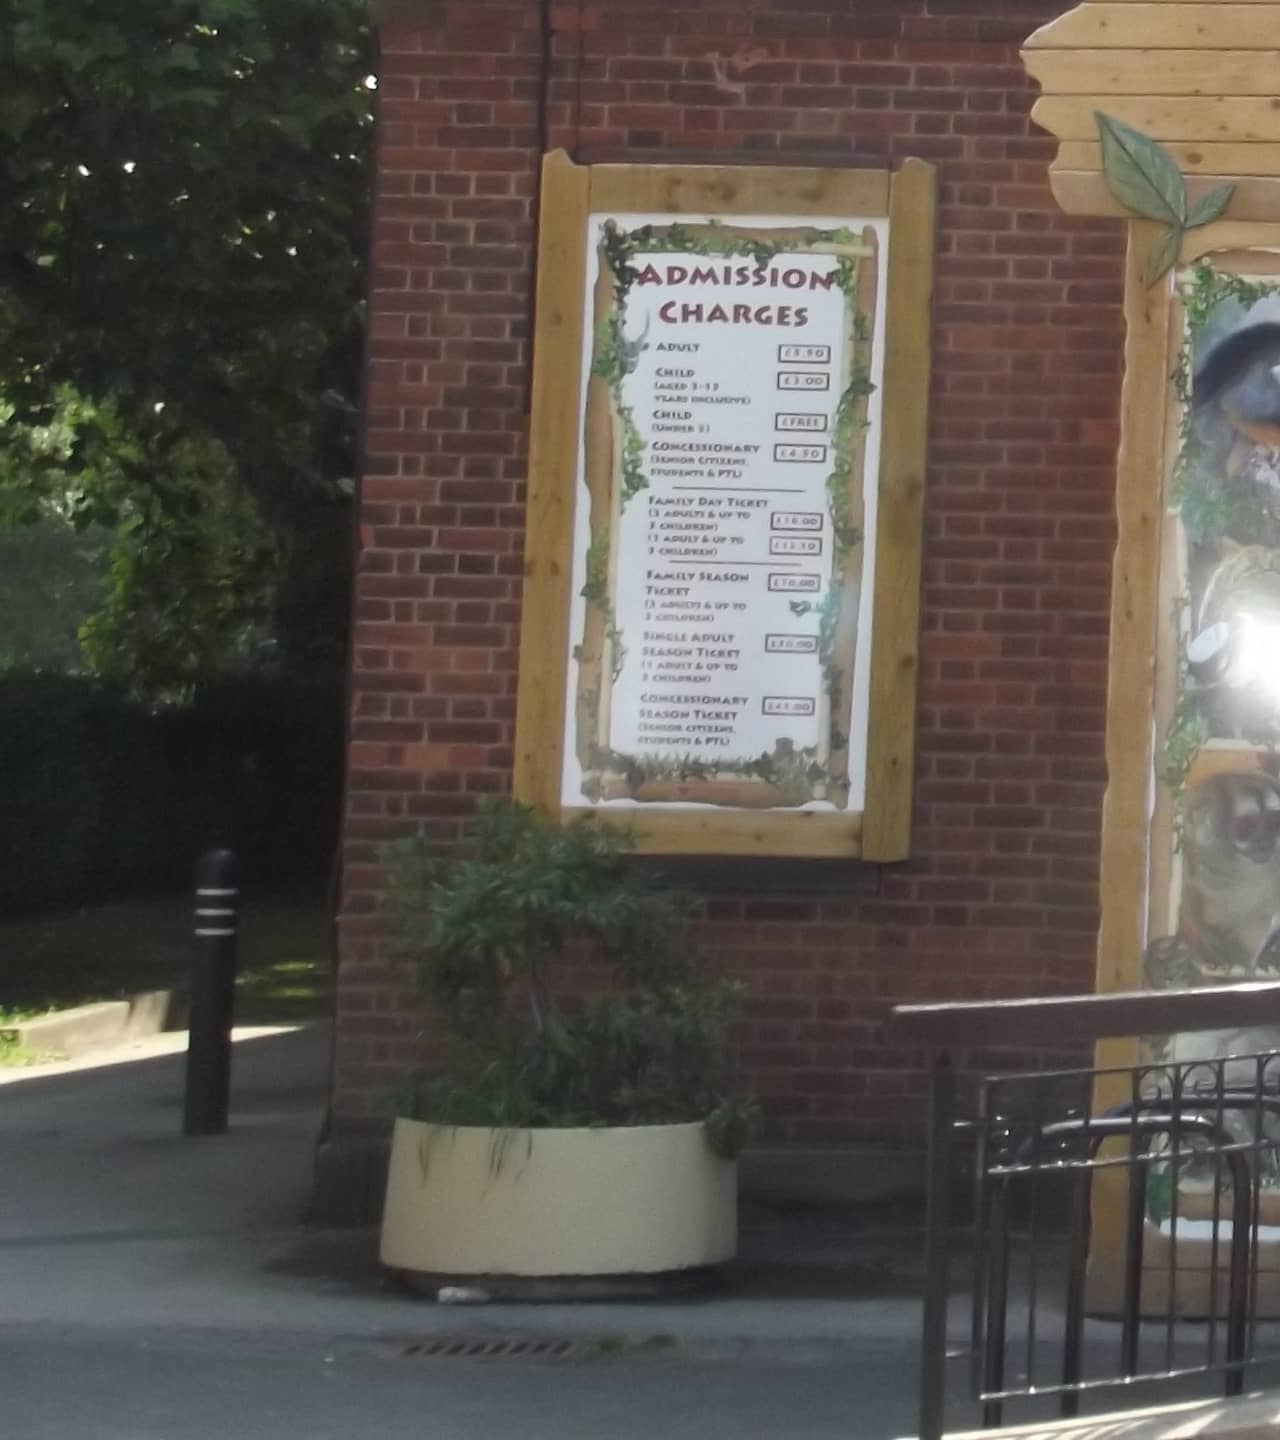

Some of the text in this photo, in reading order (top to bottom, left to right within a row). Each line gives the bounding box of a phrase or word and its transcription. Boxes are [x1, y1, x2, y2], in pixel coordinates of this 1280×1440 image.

[637, 263, 834, 290] ADMISSION
[659, 300, 809, 327] CHARGES
[656, 367, 695, 377] CHILD
[653, 410, 692, 420] CHILD
